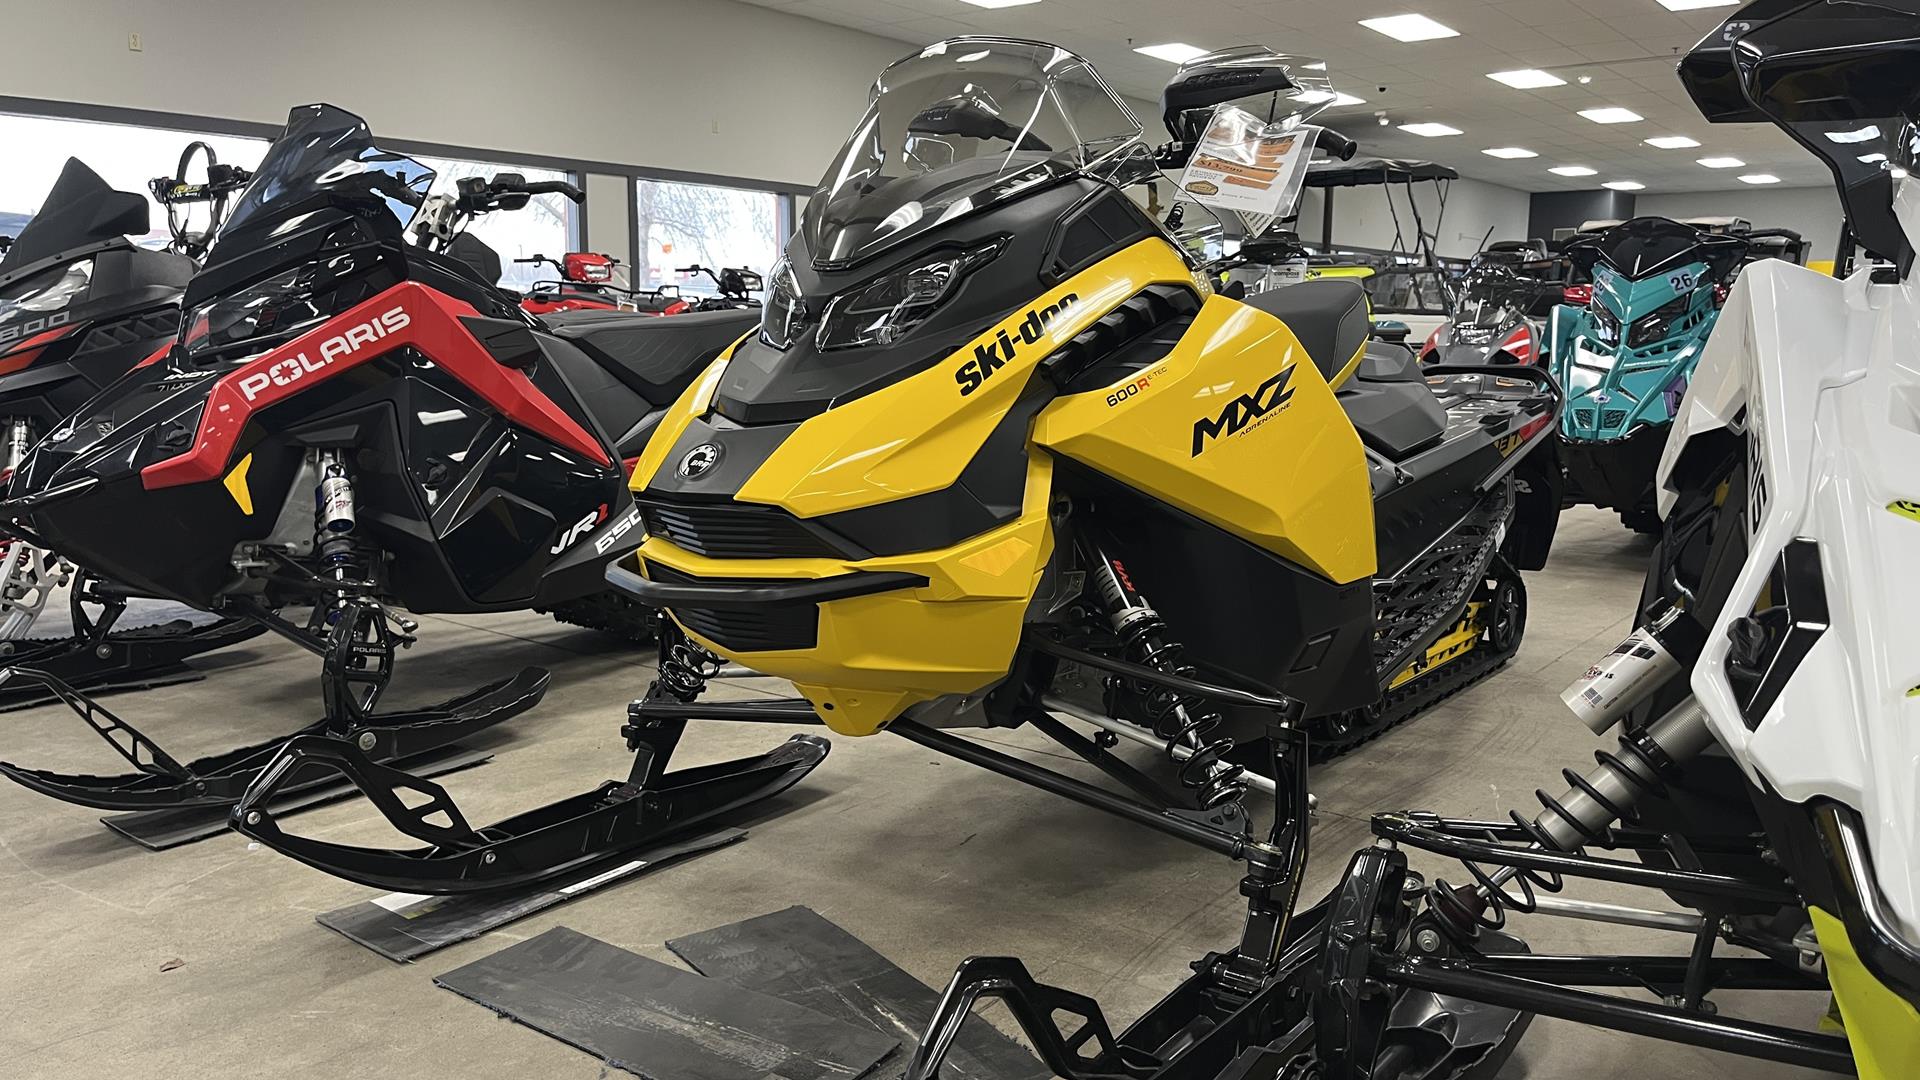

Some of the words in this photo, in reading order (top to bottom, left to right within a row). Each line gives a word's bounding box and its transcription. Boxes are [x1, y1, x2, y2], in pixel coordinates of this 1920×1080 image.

[1670, 273, 1693, 291] 26
[238, 306, 411, 401] POLARIS
[1191, 362, 1298, 459] MXZ
[1239, 402, 1292, 438] ADRENALINE
[690, 459, 710, 472] BRP
